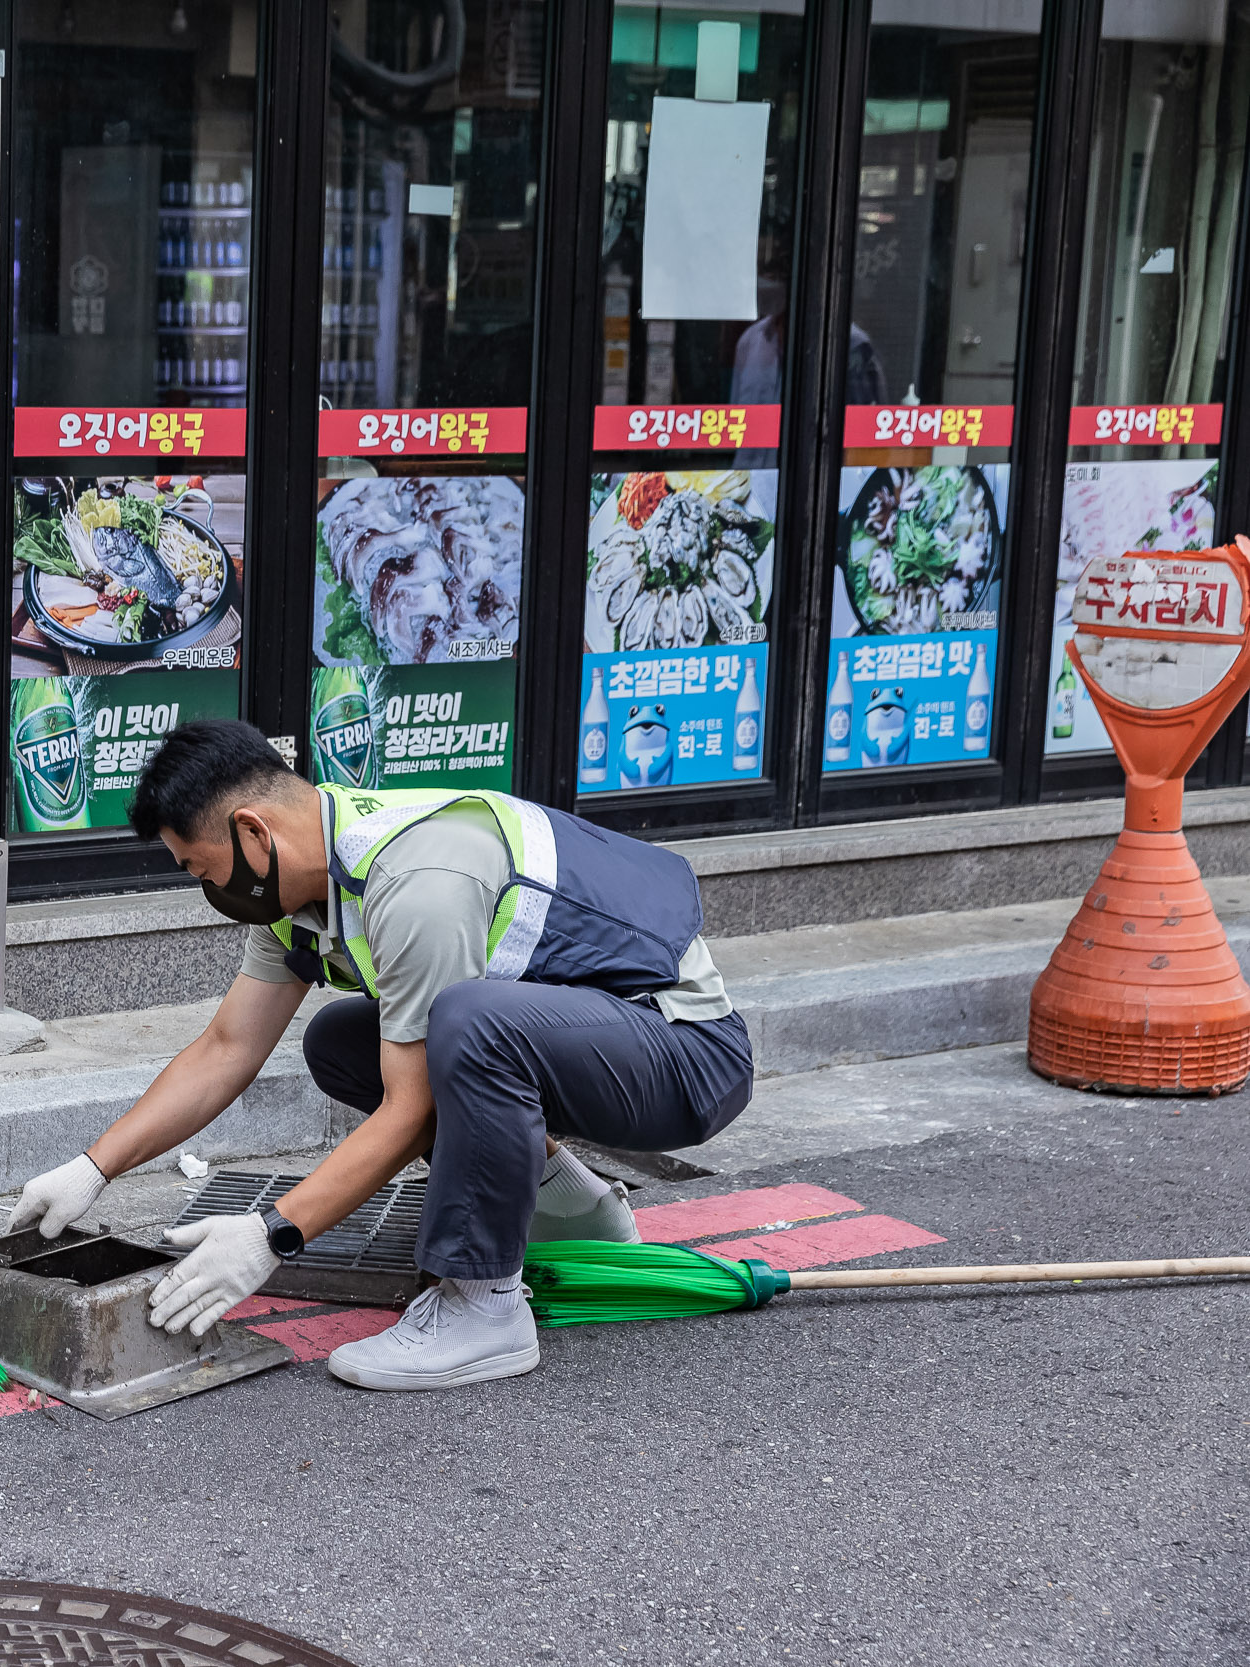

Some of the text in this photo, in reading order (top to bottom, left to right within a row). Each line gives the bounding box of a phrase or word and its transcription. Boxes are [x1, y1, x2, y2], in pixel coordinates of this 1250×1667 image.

[58, 412, 205, 456] 오징어왕국
[358, 412, 490, 454] 오징어왕국
[628, 409, 748, 448] 오징어왕국
[874, 408, 984, 446] 오징어왕국
[1094, 407, 1195, 444] 오징어왕국
[1106, 562, 1127, 574] 협조
[162, 646, 237, 670] 우럭매운탕
[447, 640, 513, 659] 새조개샤브
[852, 640, 973, 682] 초깔끔한 맛
[608, 655, 741, 699] 초깔끔한 맛
[94, 706, 123, 738] 이
[125, 703, 180, 737] 맛이
[386, 694, 412, 725] 이
[413, 691, 463, 724] 맛이
[679, 719, 706, 733] 소주의
[22, 734, 80, 773] TERRA
[321, 720, 372, 758] TERRA
[384, 721, 509, 759] 청정라거다!
[93, 776, 134, 791] 리얼탄산
[383, 760, 421, 775] 리얼탄산
[420, 759, 442, 772] 100%
[483, 755, 505, 768] 100%
